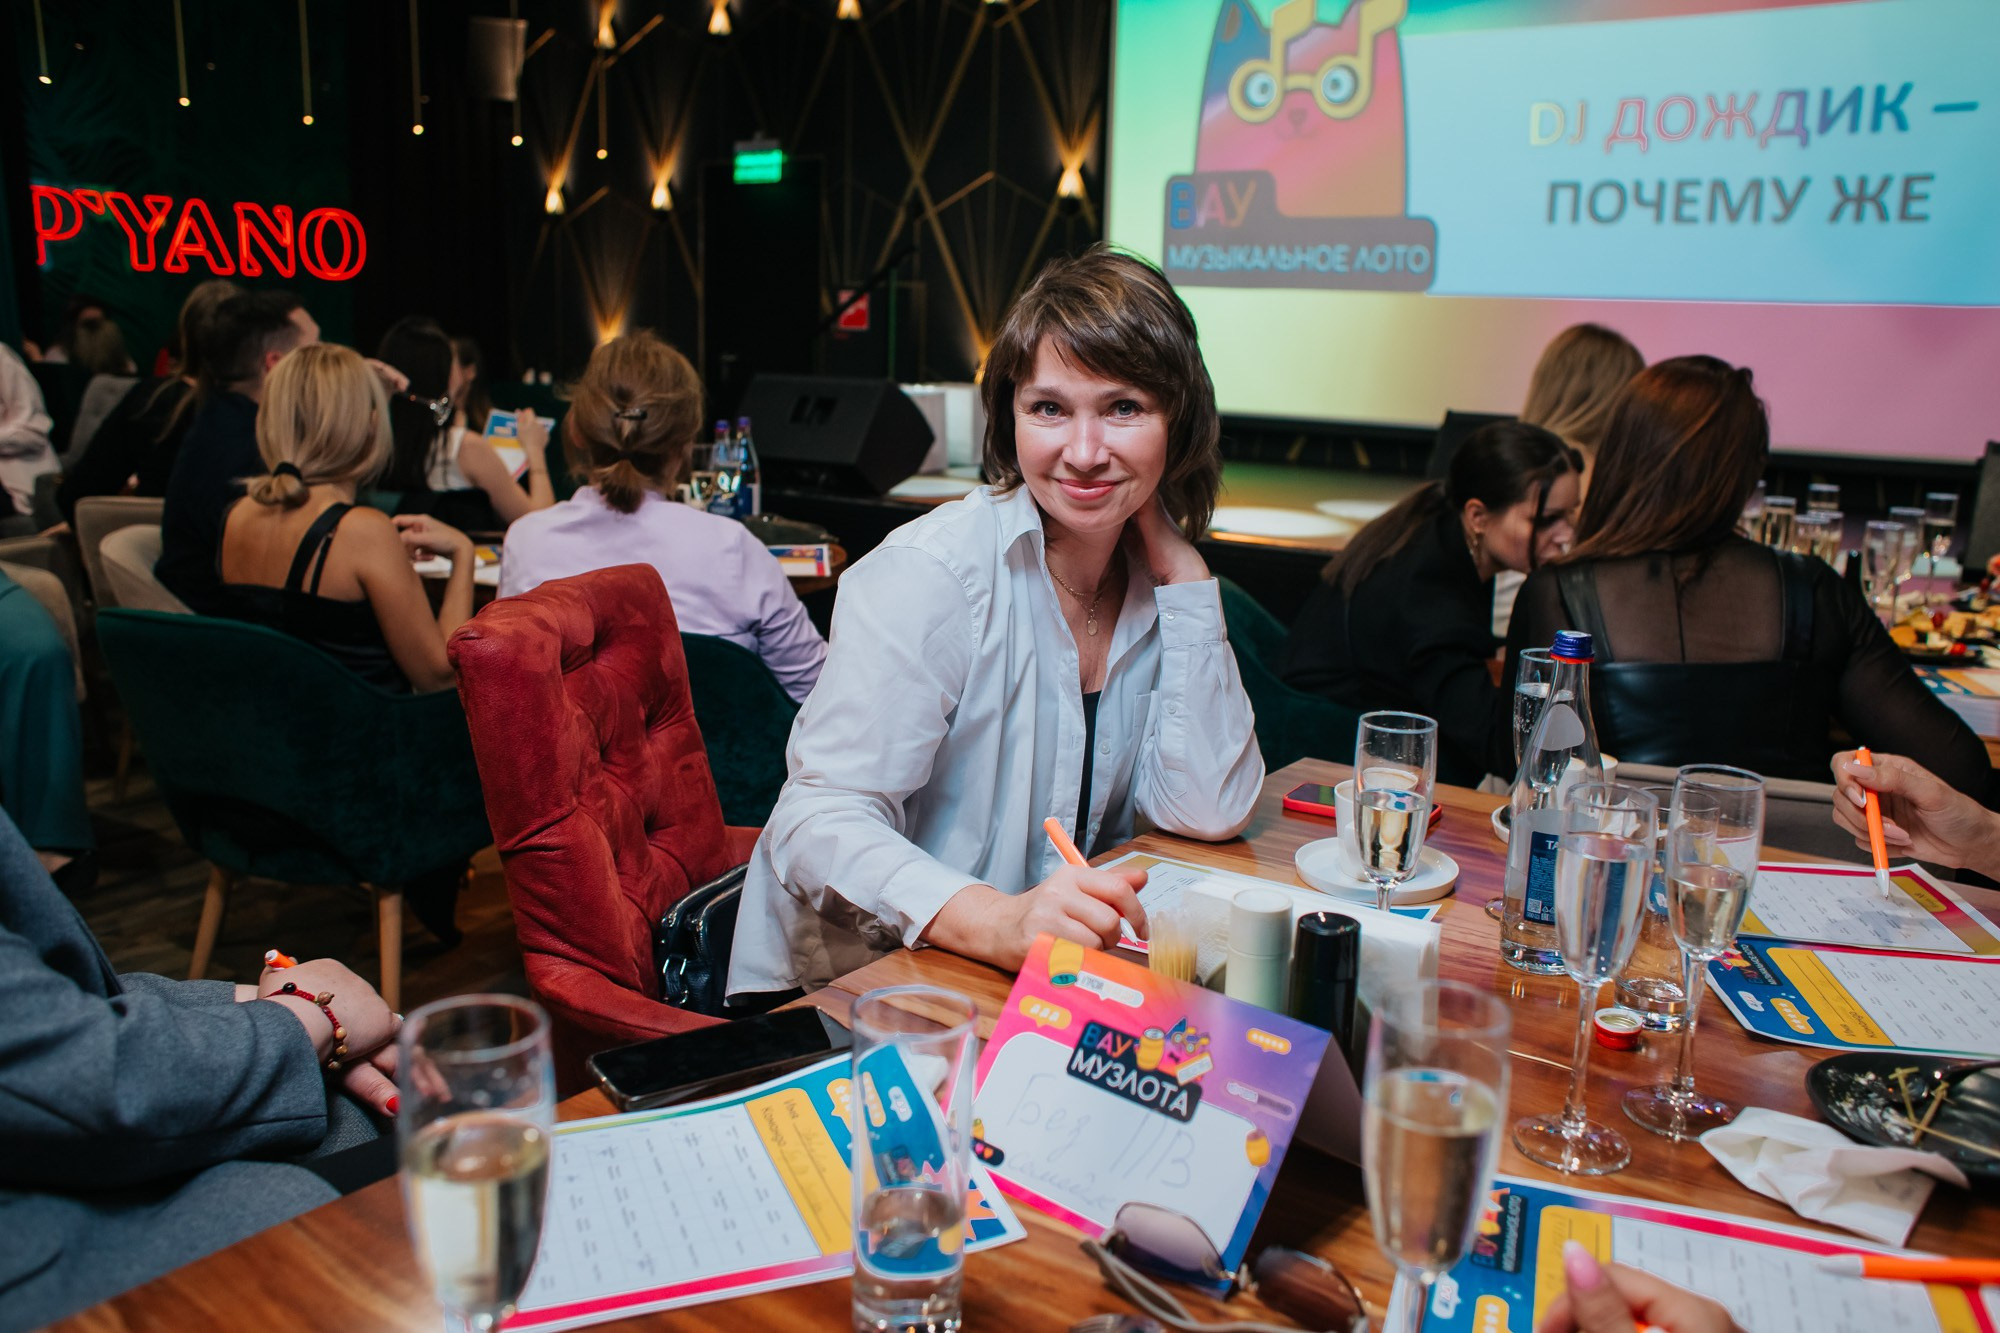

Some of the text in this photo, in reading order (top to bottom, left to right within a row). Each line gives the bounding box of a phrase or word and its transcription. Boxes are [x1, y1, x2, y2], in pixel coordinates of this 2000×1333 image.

[1529, 101, 1586, 146] DJ
[1604, 81, 1914, 154] ДОЖДИК
[1169, 180, 1258, 230] ВАУ
[1547, 172, 1936, 225] ПОЧЕМУ ЖЕ
[1167, 243, 1431, 274] МУЗЫКАЛЬНОЕ ЛОТО
[1082, 1022, 1133, 1059] ВАУ
[1070, 1048, 1189, 1117] МУЗЛОТА
